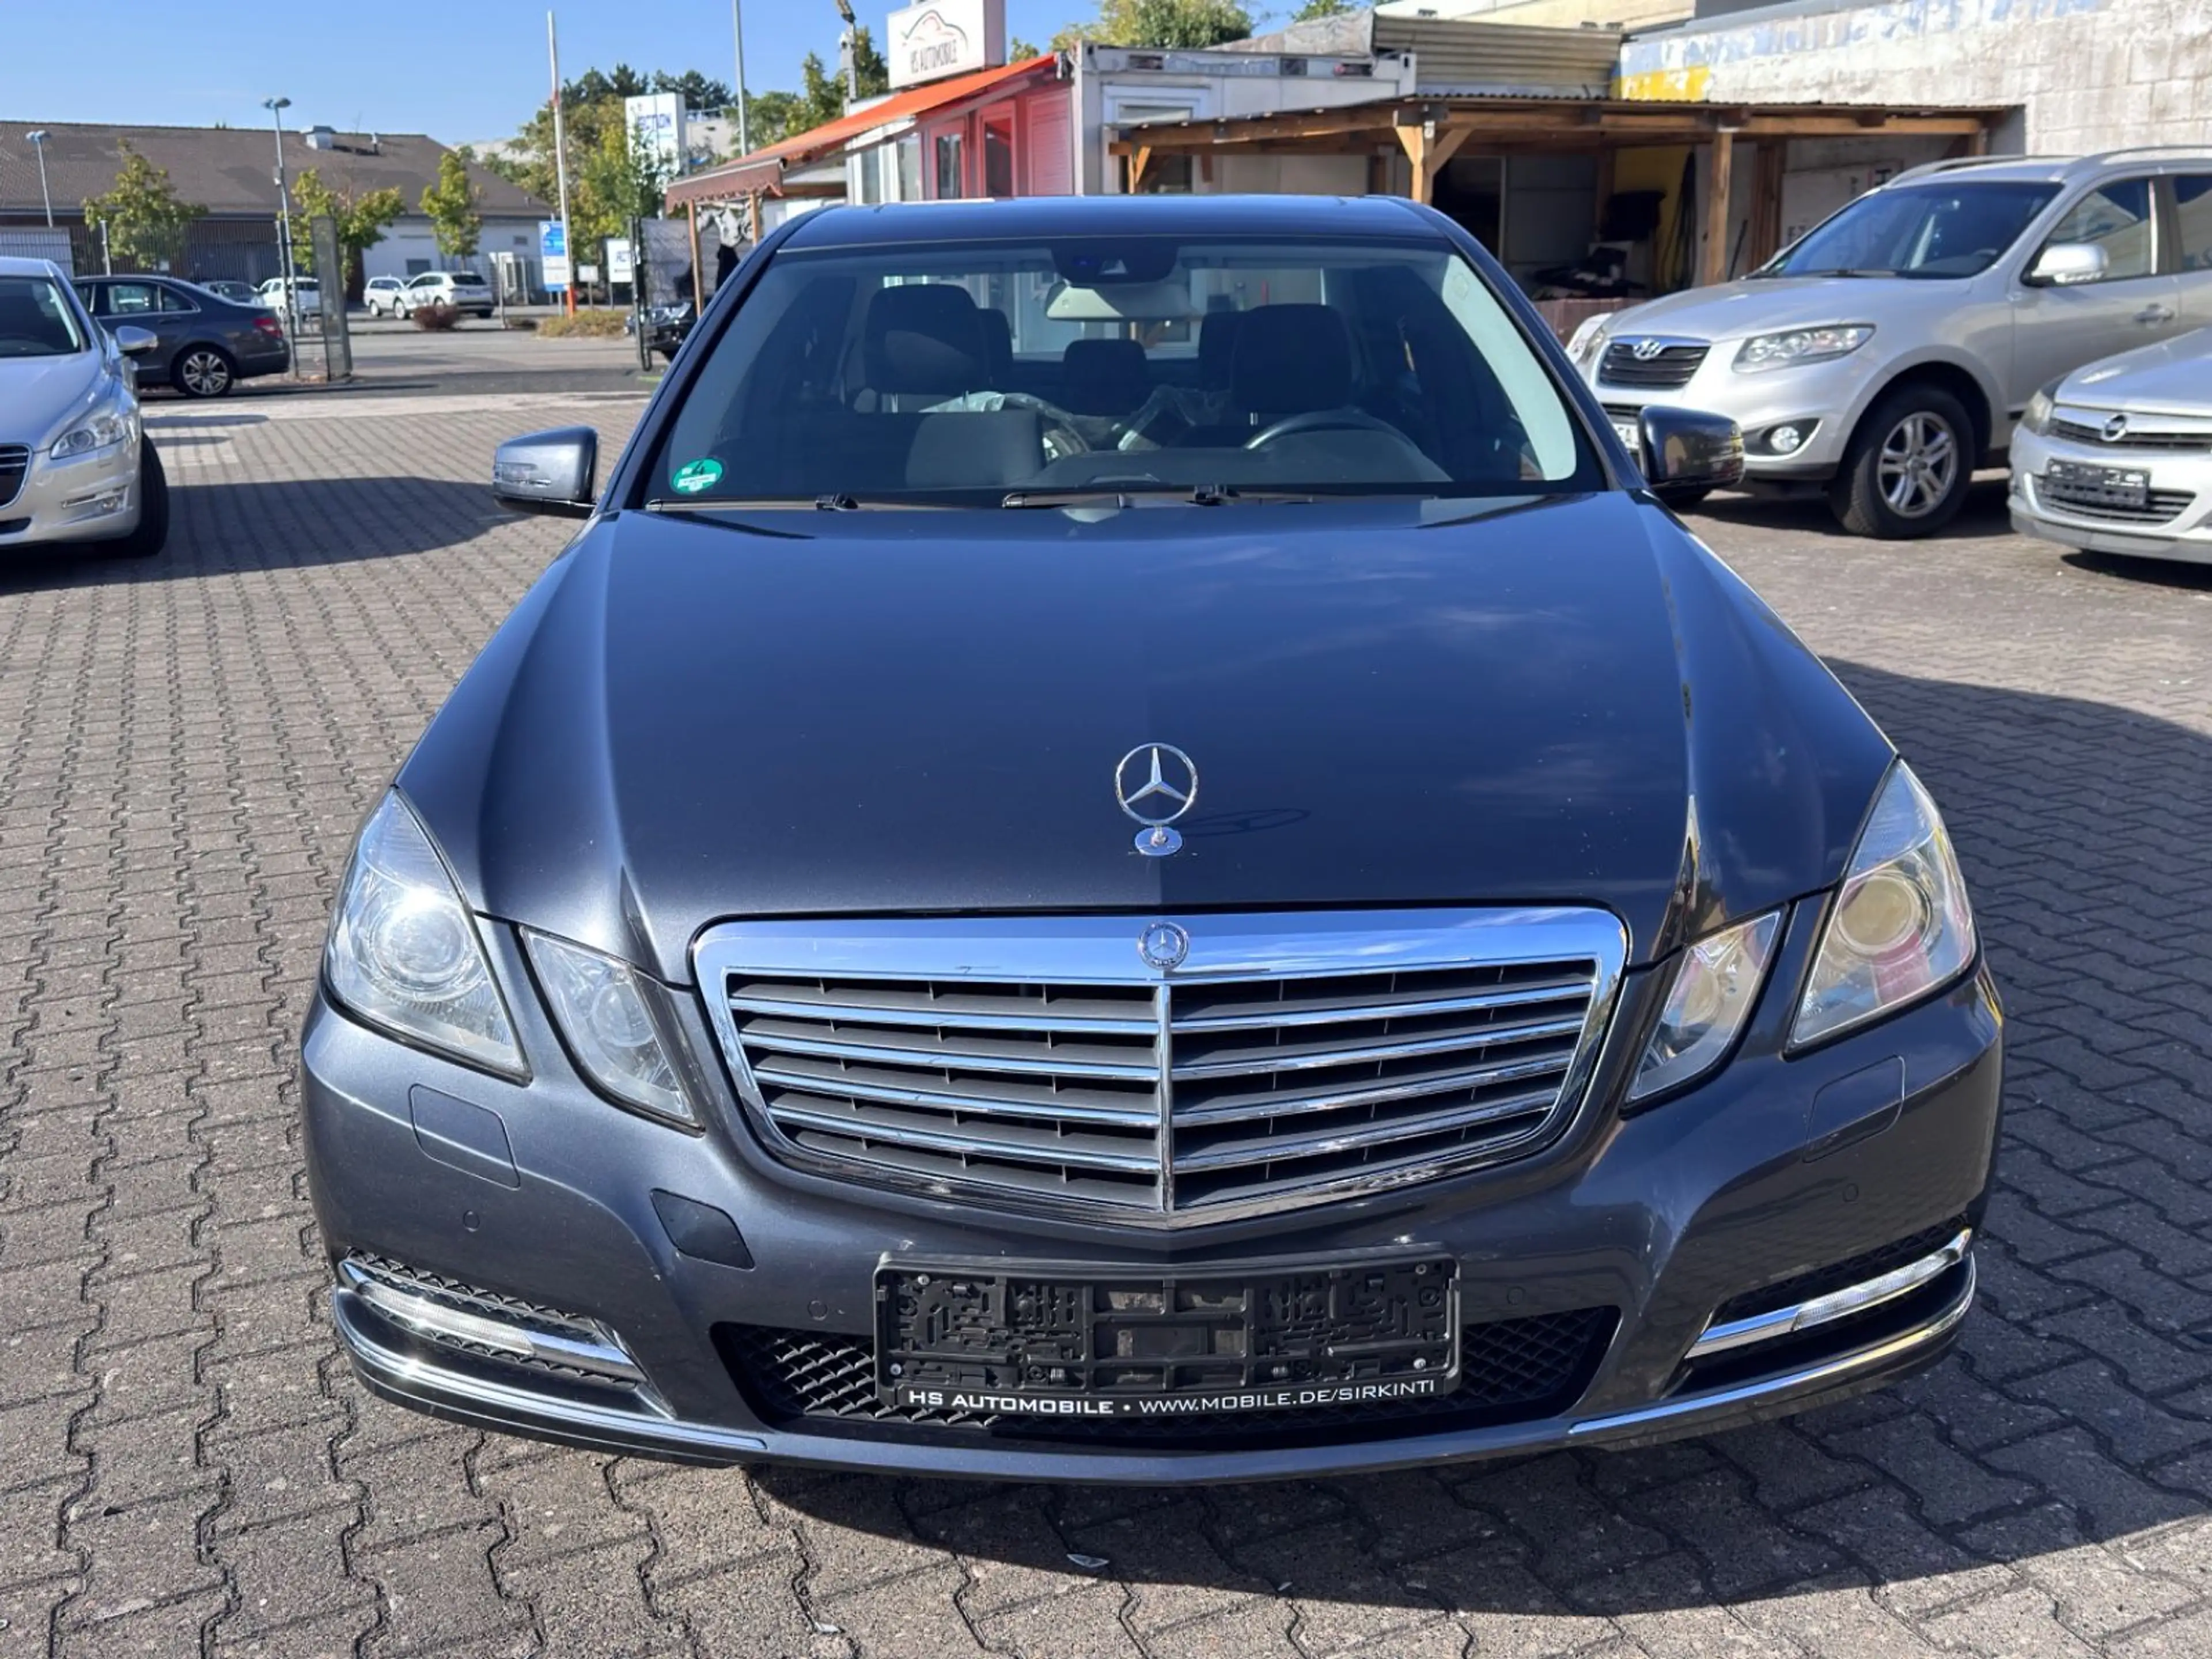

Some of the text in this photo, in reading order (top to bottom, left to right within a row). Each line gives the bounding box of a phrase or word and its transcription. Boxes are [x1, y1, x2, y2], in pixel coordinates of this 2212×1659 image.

[908, 1379, 1435, 1415] HS AUTOMOBILE WWW.MOBILE.DE/SIRKINTI
